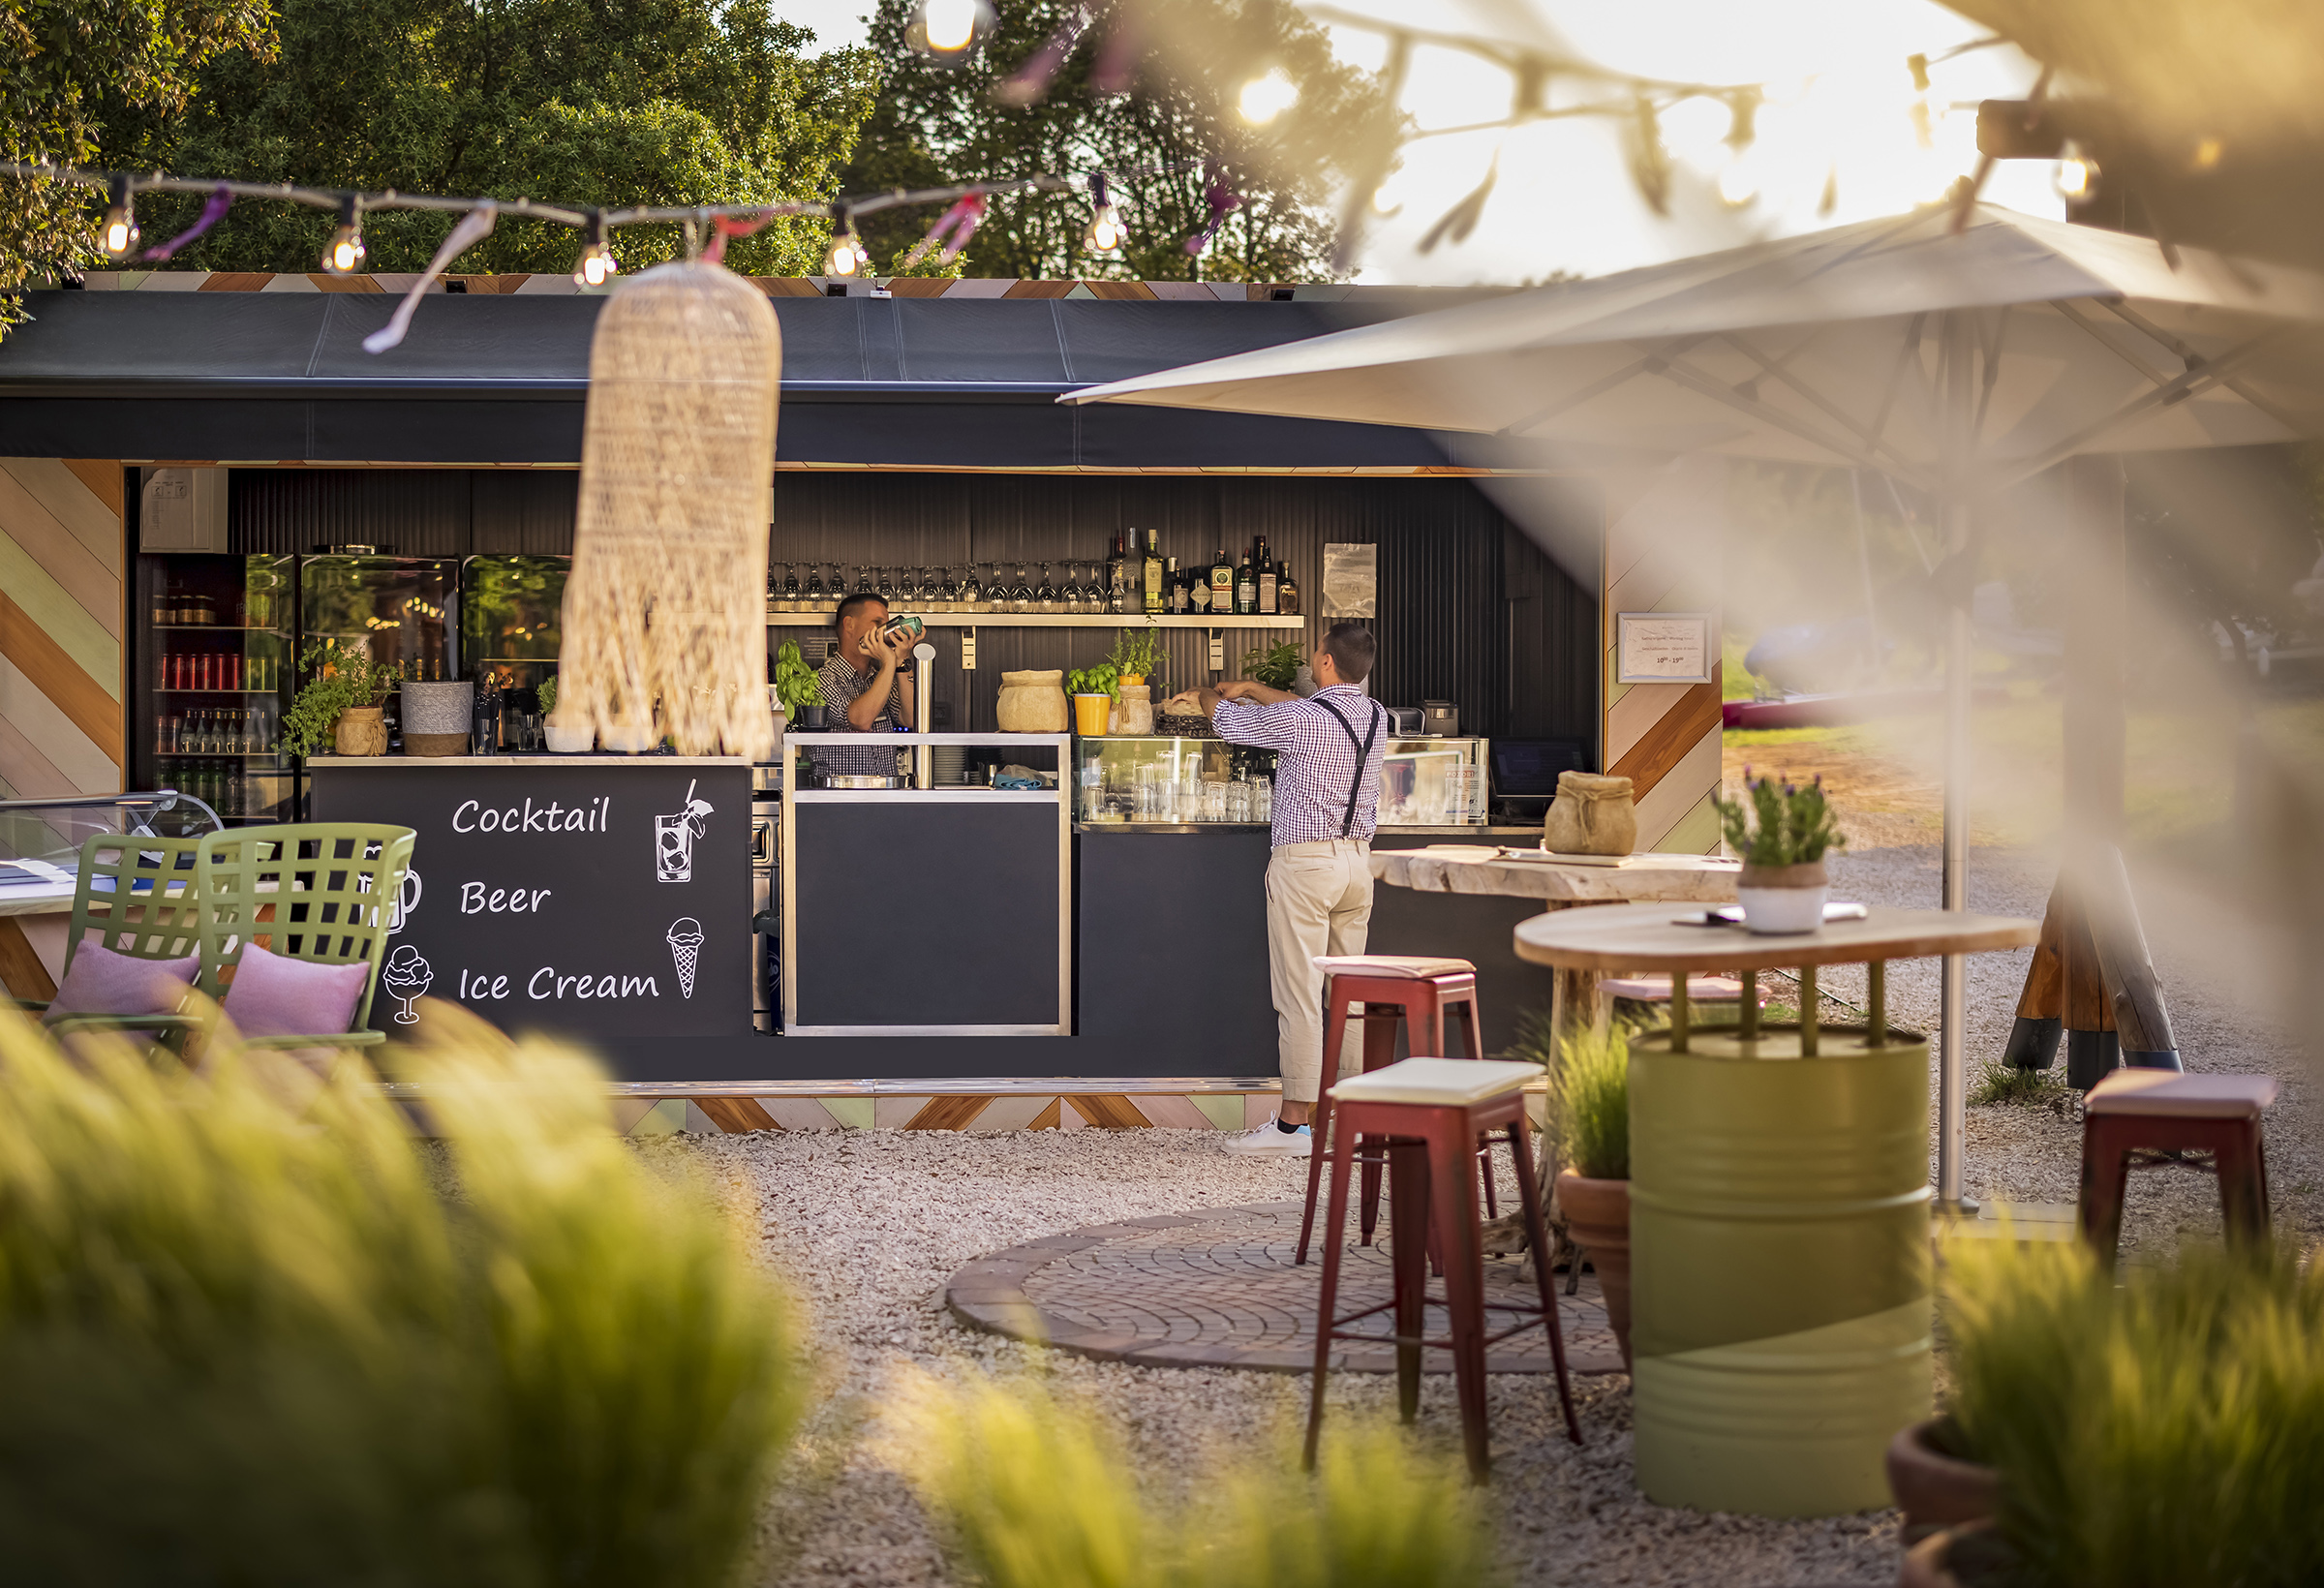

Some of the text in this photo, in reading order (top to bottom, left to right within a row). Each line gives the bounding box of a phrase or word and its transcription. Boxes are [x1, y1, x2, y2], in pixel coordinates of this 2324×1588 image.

[451, 796, 610, 834] Cocktail
[460, 881, 552, 915] Beer
[459, 966, 660, 1000] Ice Cream
